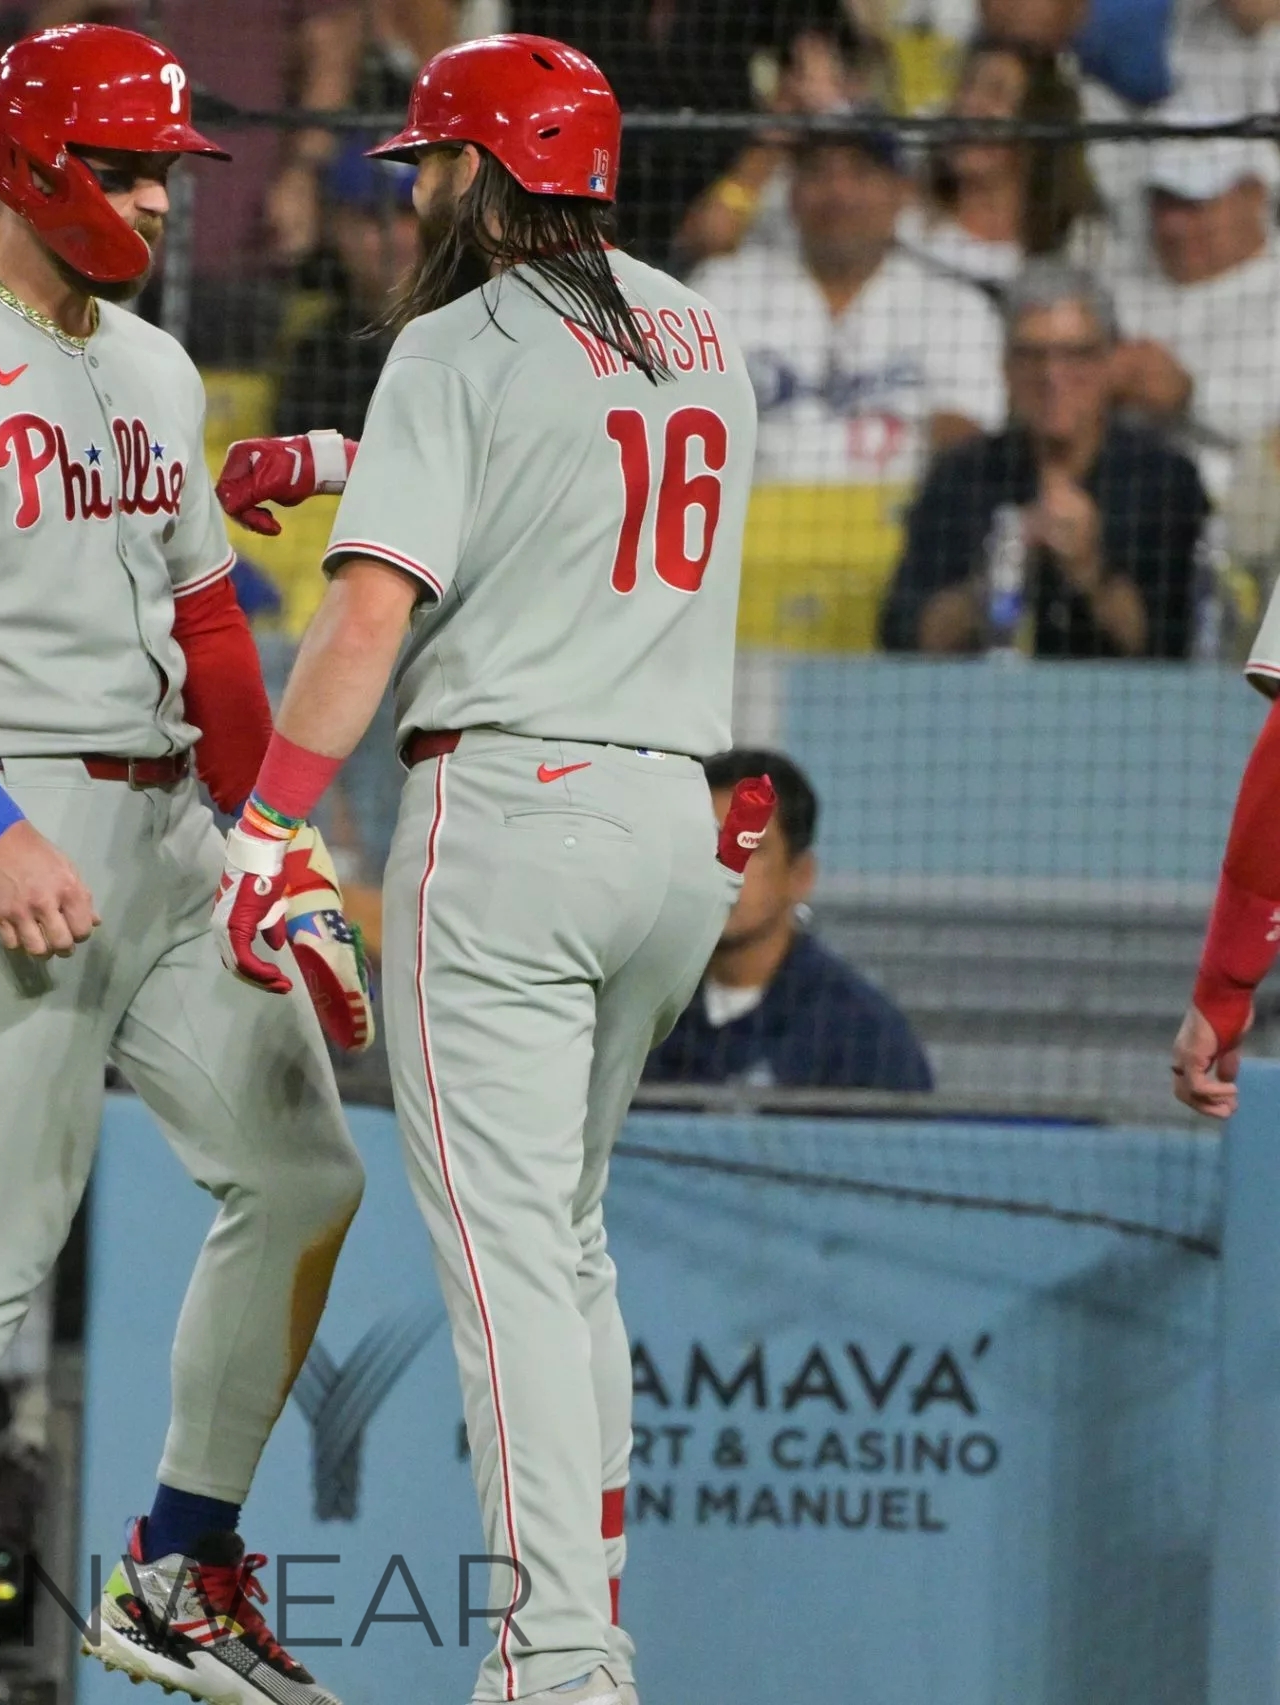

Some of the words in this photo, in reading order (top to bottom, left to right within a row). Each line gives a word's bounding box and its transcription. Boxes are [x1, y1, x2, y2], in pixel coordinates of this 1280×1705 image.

[160, 63, 186, 114] P
[593, 147, 609, 176] 16
[605, 404, 729, 596] 16
[714, 1425, 748, 1470] &
[770, 1425, 1000, 1476] CASINO
[695, 1482, 948, 1533] MANUEL
